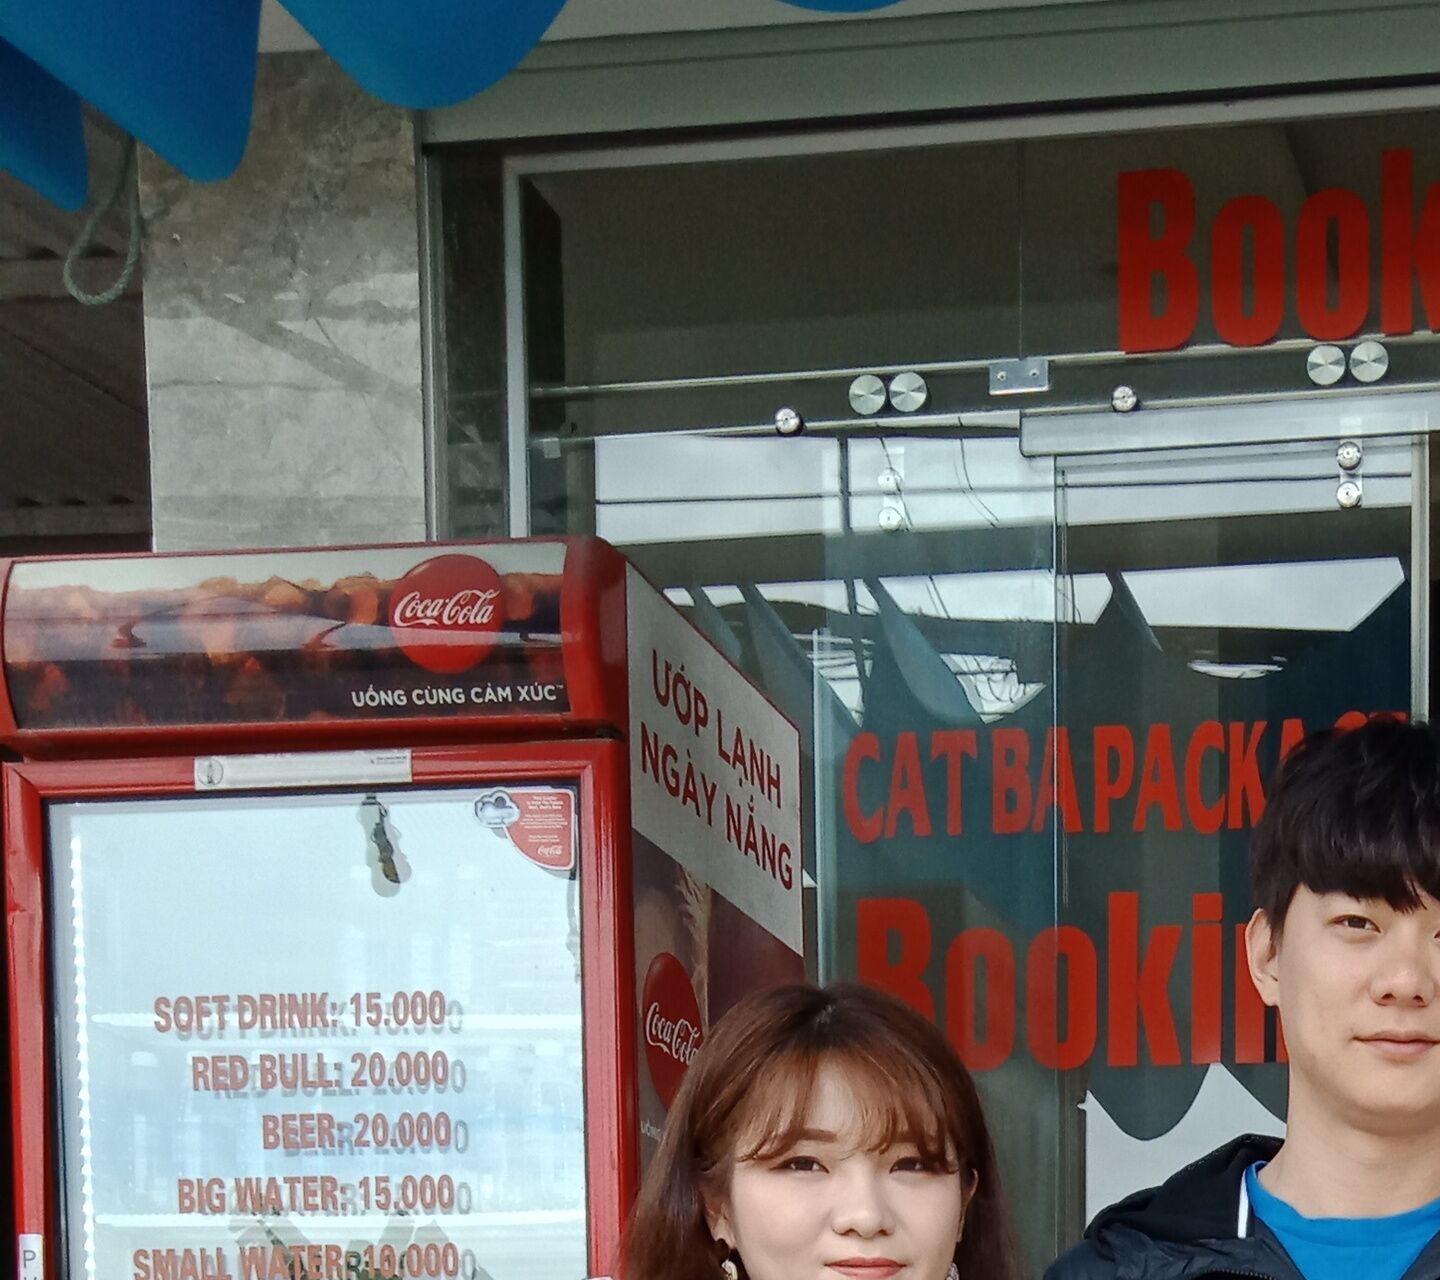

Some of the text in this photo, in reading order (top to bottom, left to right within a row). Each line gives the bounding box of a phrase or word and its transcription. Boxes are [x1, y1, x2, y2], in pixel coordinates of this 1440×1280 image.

[394, 589, 500, 627] Coca-Cola
[641, 721, 717, 827] NGÀY
[717, 708, 782, 809] LẠNH
[842, 728, 979, 843] CAT
[991, 726, 1084, 834] BA
[153, 990, 446, 1033] SOFT DRINK: 15.000
[192, 1050, 449, 1091] RED BULL: 20.000
[262, 1111, 452, 1150] BEER: 20.000
[177, 1173, 455, 1214] BIG WATER: 15.000
[362, 1242, 460, 1280] 10.000
